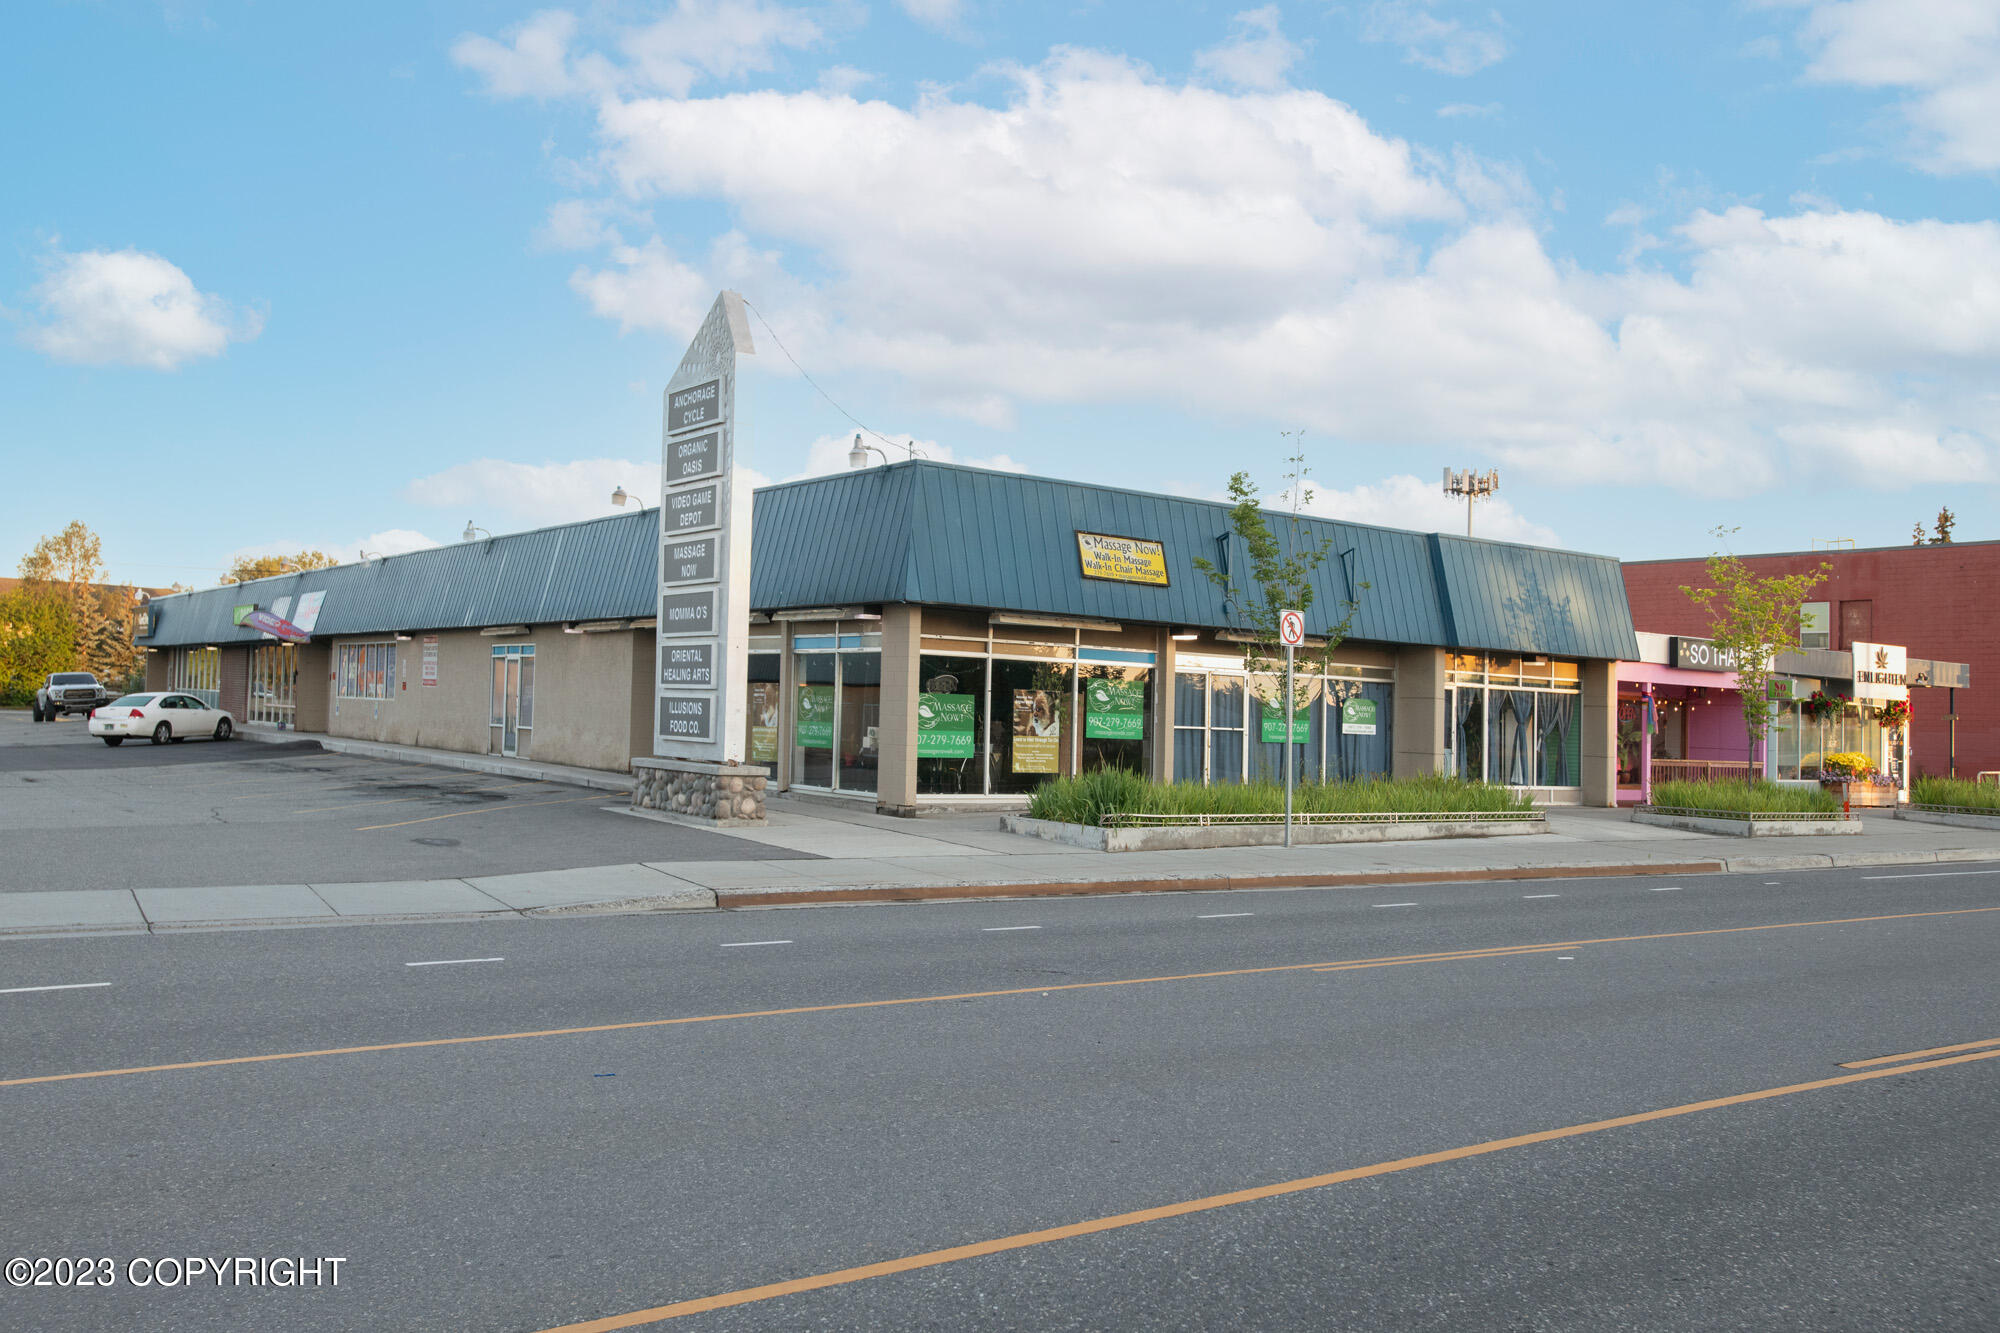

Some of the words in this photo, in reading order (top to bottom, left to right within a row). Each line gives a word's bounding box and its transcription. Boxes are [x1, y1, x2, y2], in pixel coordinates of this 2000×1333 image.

[673, 385, 716, 408] ANCHORAGE
[683, 407, 705, 424] CYCLE
[678, 439, 708, 458] ORGANIC
[682, 459, 703, 475] OASIS
[671, 494, 691, 509] VIDEO
[692, 490, 712, 506] GAME
[680, 511, 702, 527] DEPOT
[673, 543, 706, 560] MASSAGE
[1093, 537, 1132, 554] Massage
[1135, 541, 1160, 556] Now!
[1093, 551, 1122, 563] Walk-In
[1123, 555, 1152, 567] Massage
[681, 563, 697, 577] NOW
[1084, 559, 1113, 571] Walk-In
[1114, 563, 1133, 574] Chair
[1135, 566, 1164, 578] Massage
[669, 607, 695, 621] MOMMA
[696, 605, 708, 619] O'S
[671, 649, 703, 662] ORIENTAL
[1690, 644, 1709, 665] SO
[663, 668, 691, 681] HEALING
[692, 667, 710, 681] ARTS
[1857, 671, 1907, 686] ENLIGHTEN
[669, 702, 703, 715] ILLUSIONS
[934, 701, 972, 712] MASSAGE
[669, 720, 687, 733] FOOD
[688, 721, 700, 734] CO.
[1264, 722, 1309, 733] 907-277669
[918, 734, 972, 745] 07-279-7669
